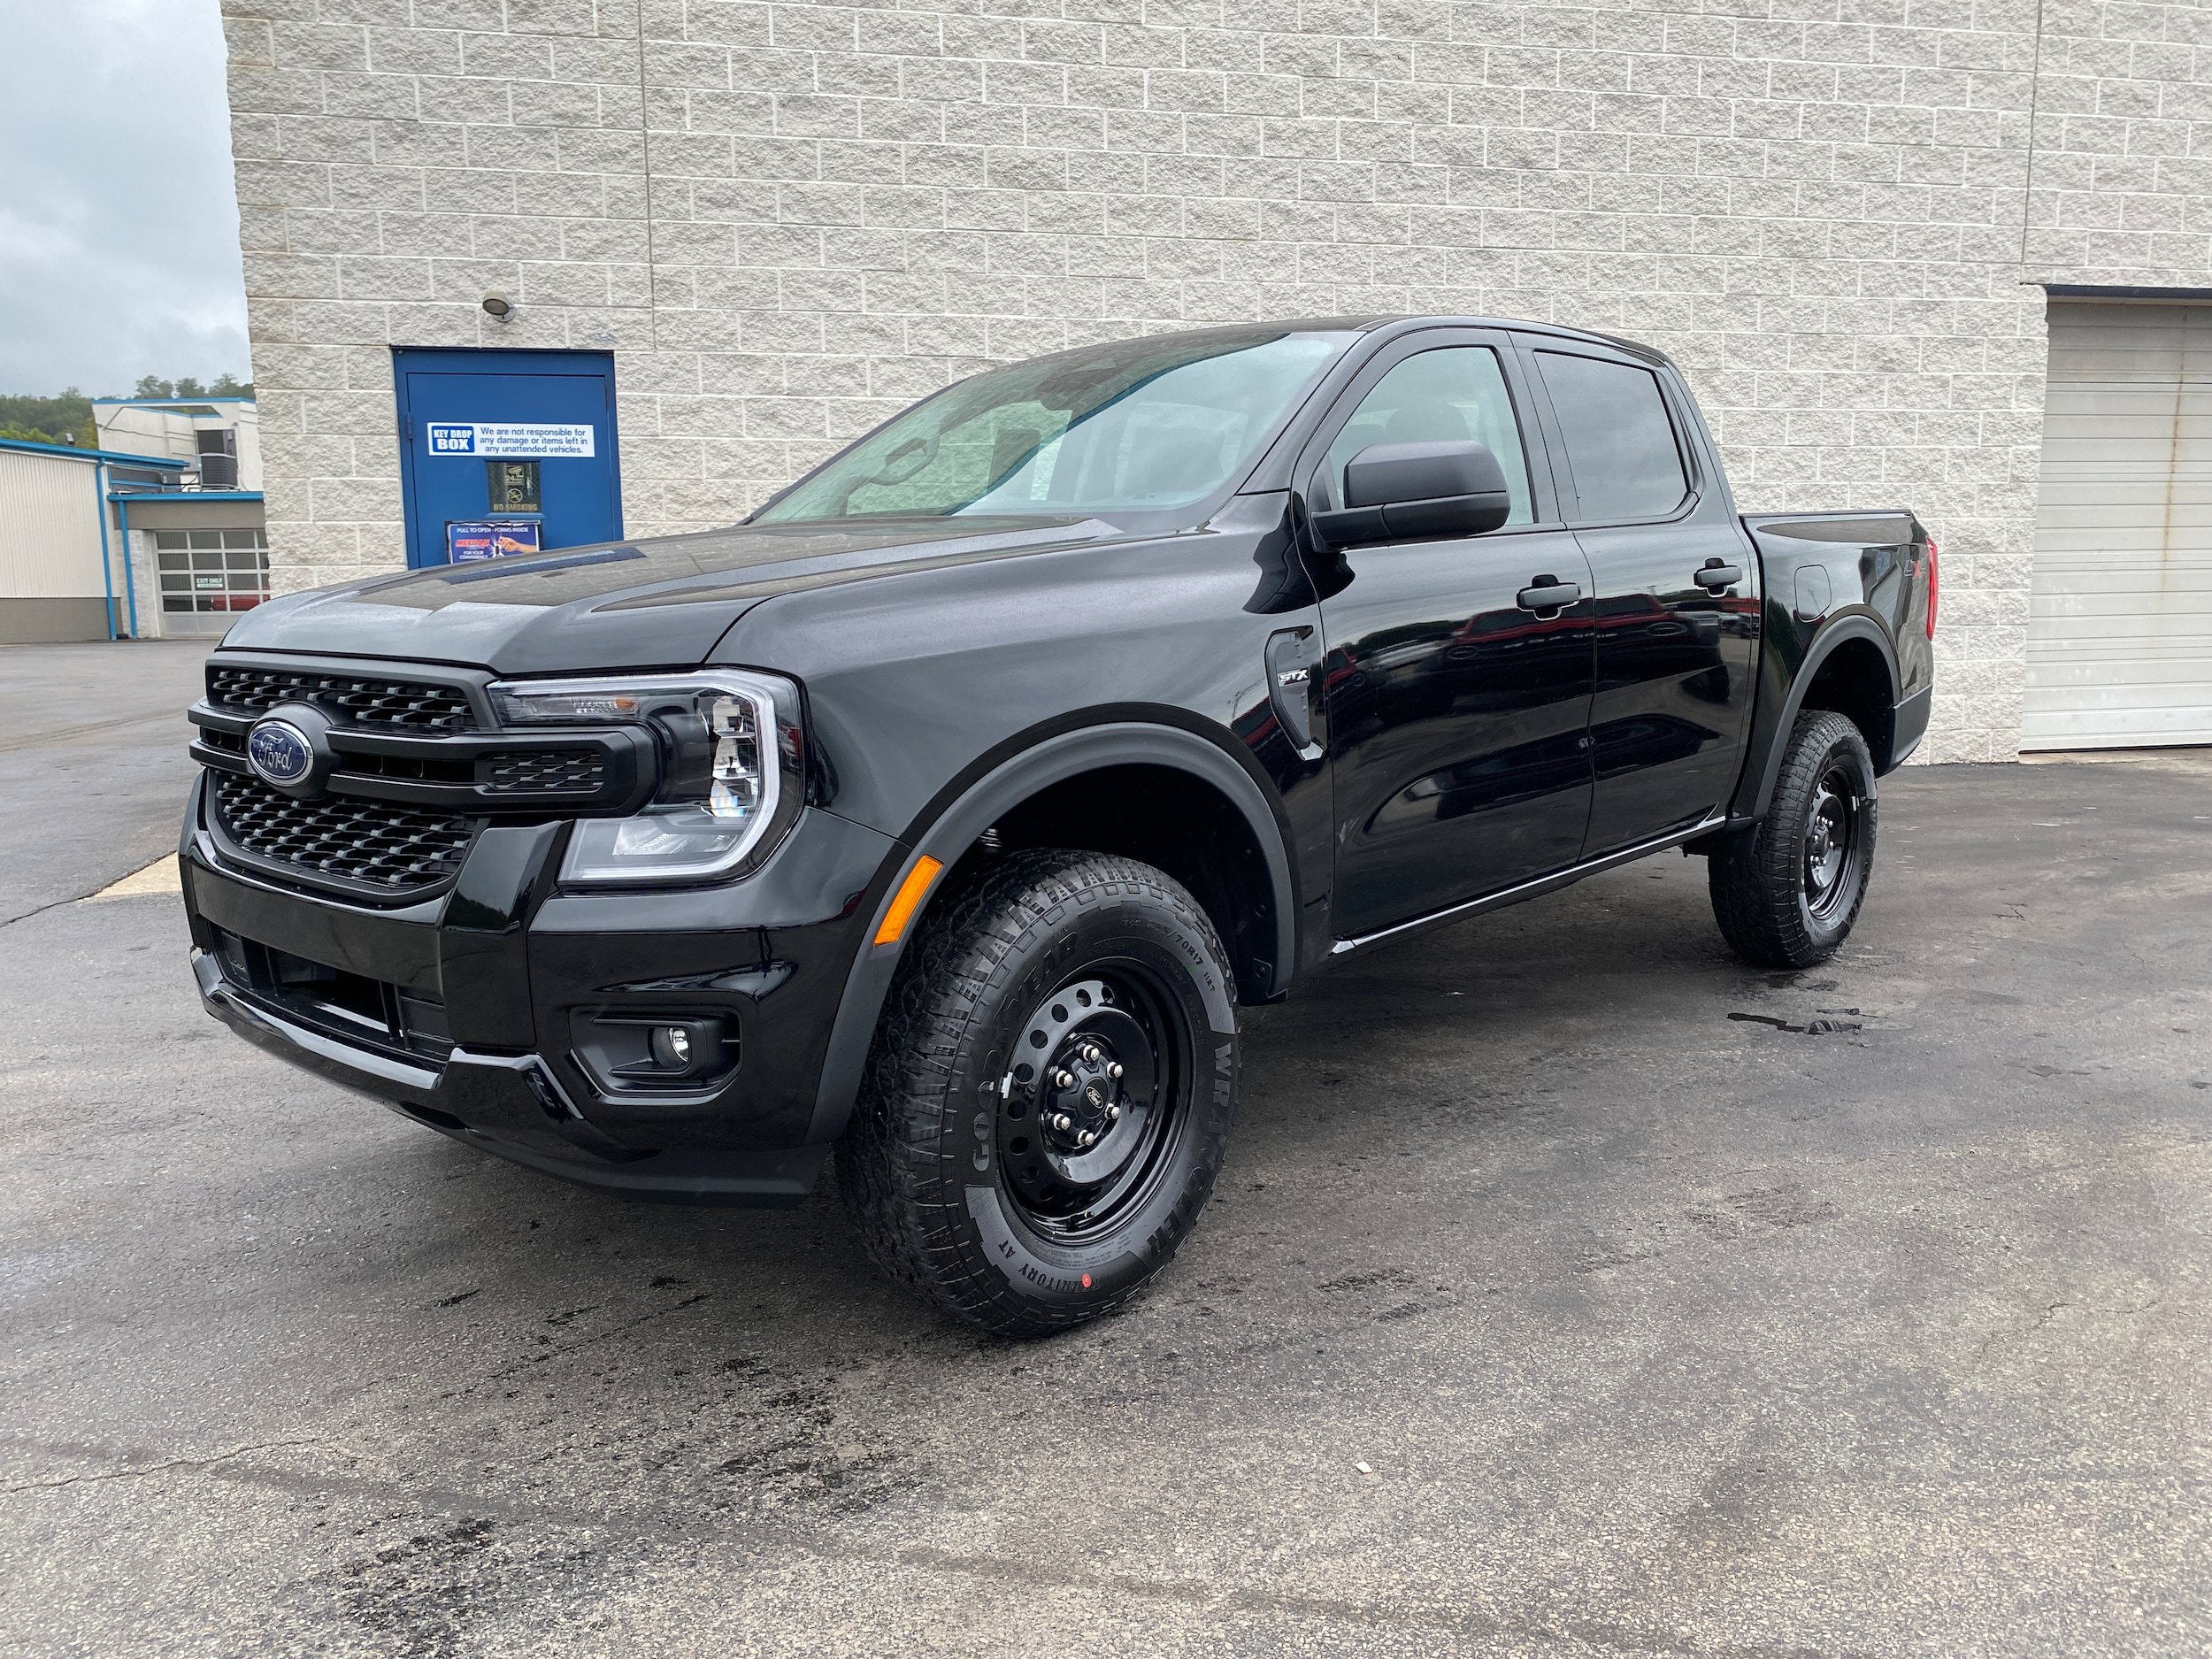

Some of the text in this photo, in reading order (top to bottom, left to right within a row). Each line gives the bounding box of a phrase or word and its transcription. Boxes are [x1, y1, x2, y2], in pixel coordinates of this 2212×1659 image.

[433, 429, 473, 439] KEY DROP
[480, 426, 495, 435] We
[526, 427, 572, 438] responsible
[437, 438, 470, 450] BOX
[480, 437, 495, 446] any
[496, 436, 529, 446] damage
[549, 445, 584, 454] vehicles.
[1279, 669, 1310, 685] STX
[252, 733, 293, 772] Ford
[997, 1239, 1018, 1260] AT
